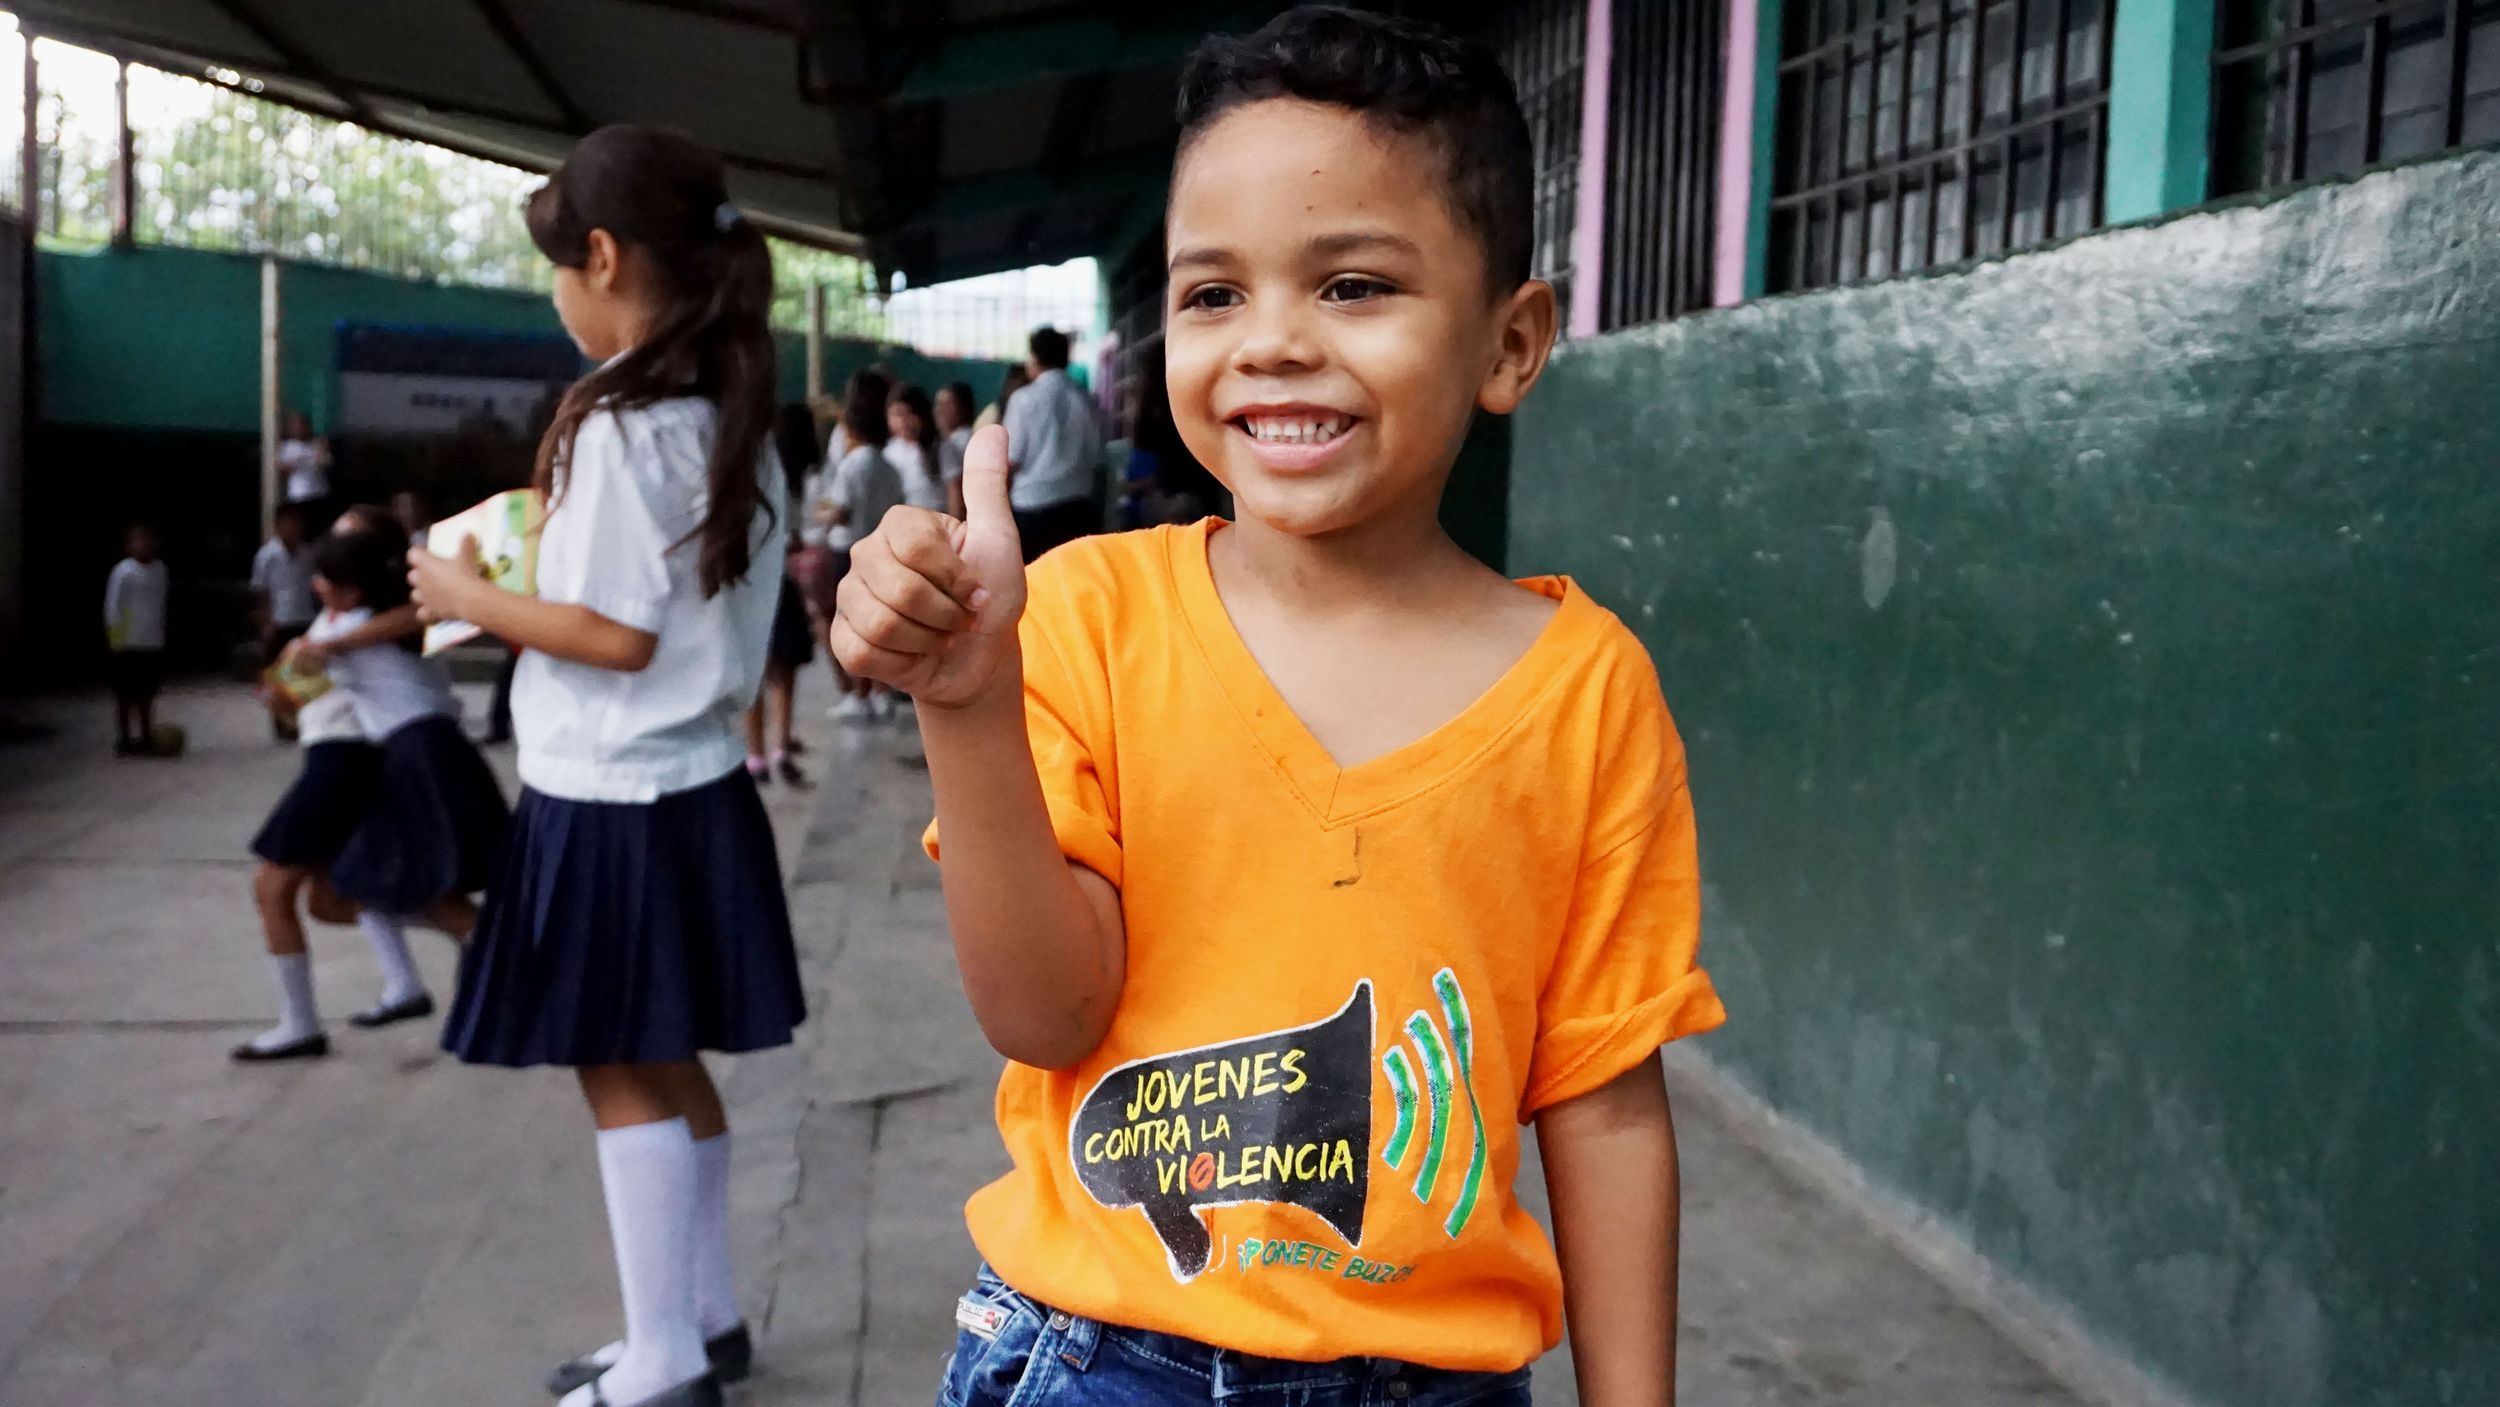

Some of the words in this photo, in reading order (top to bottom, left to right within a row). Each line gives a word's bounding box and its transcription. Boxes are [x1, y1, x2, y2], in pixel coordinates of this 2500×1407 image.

[1126, 1049, 1308, 1121] JOVENES
[1084, 1114, 1191, 1164] CONTRA
[1200, 1115, 1230, 1142] LA
